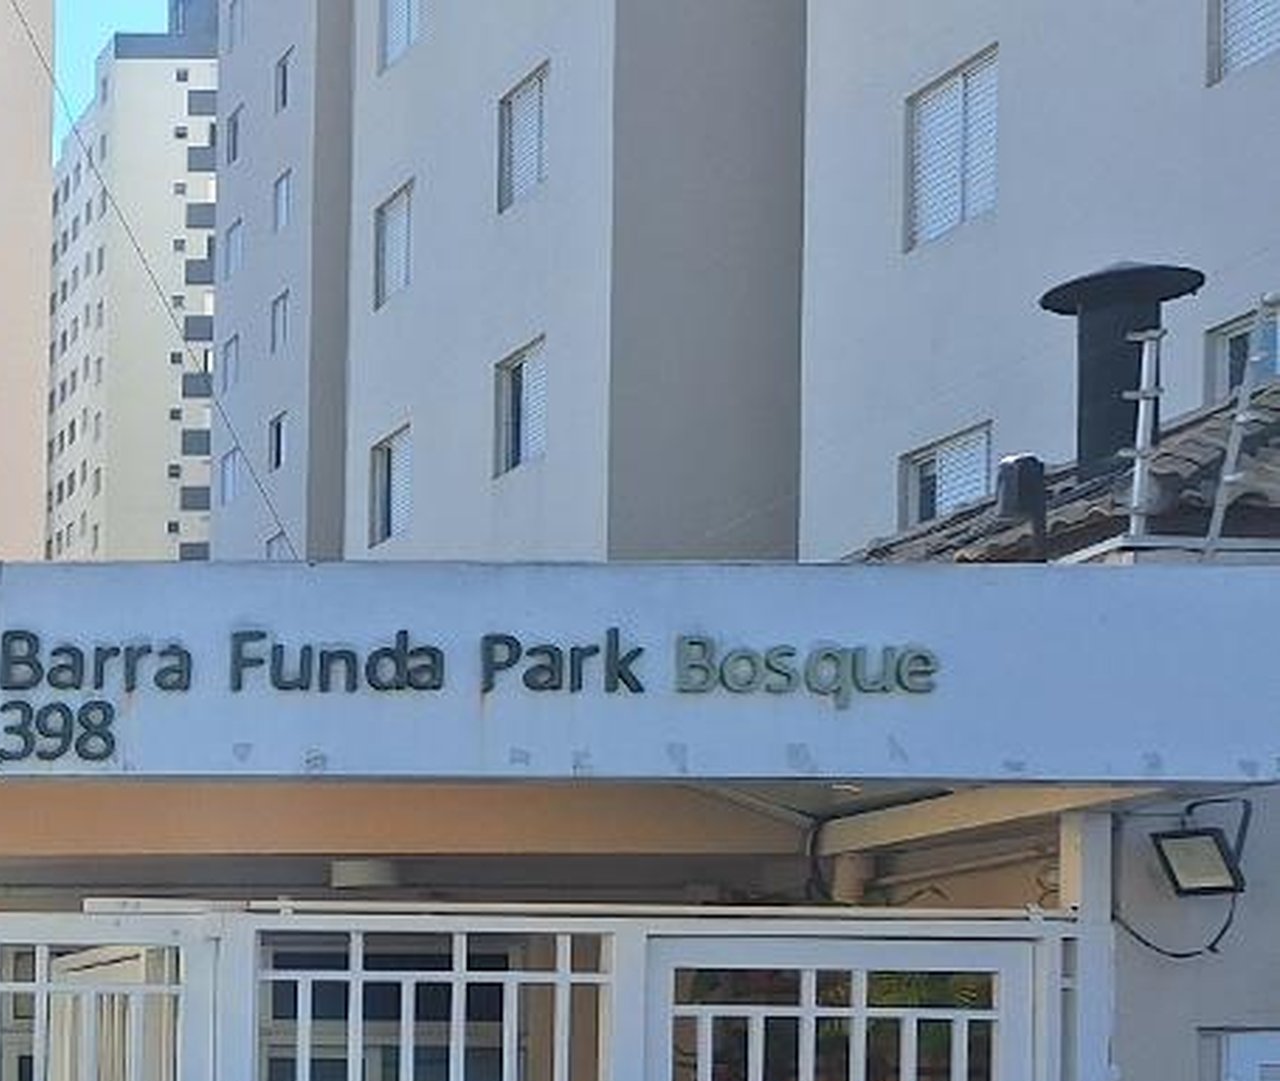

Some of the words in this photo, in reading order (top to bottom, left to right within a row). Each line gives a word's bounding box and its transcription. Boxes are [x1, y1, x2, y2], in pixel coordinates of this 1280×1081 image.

[228, 629, 444, 692] Funda
[480, 629, 644, 692] Park
[673, 632, 940, 709] Bosque
